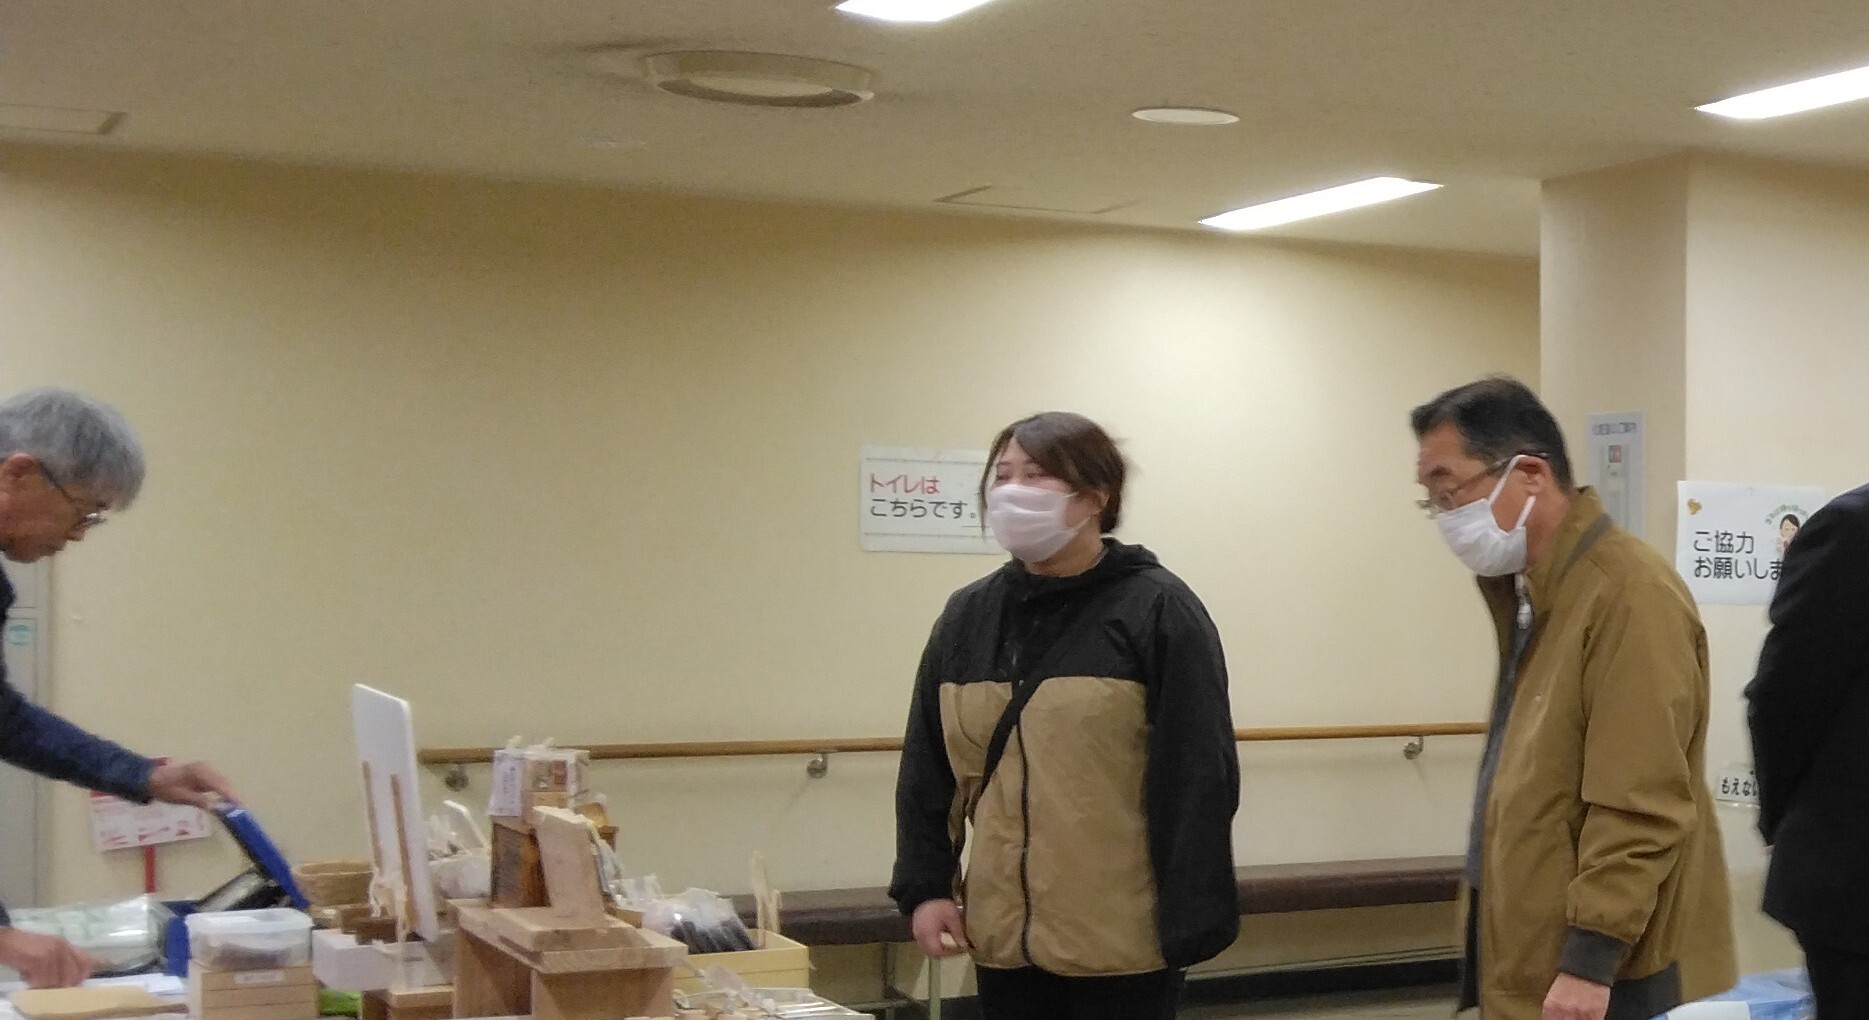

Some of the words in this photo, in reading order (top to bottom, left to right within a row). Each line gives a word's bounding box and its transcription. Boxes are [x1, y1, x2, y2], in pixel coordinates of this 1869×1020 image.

[869, 473, 940, 495] トイレは
[869, 498, 976, 519] こちらです。
[1693, 530, 1755, 555] ご協力
[1694, 556, 1784, 580] お願いしま
